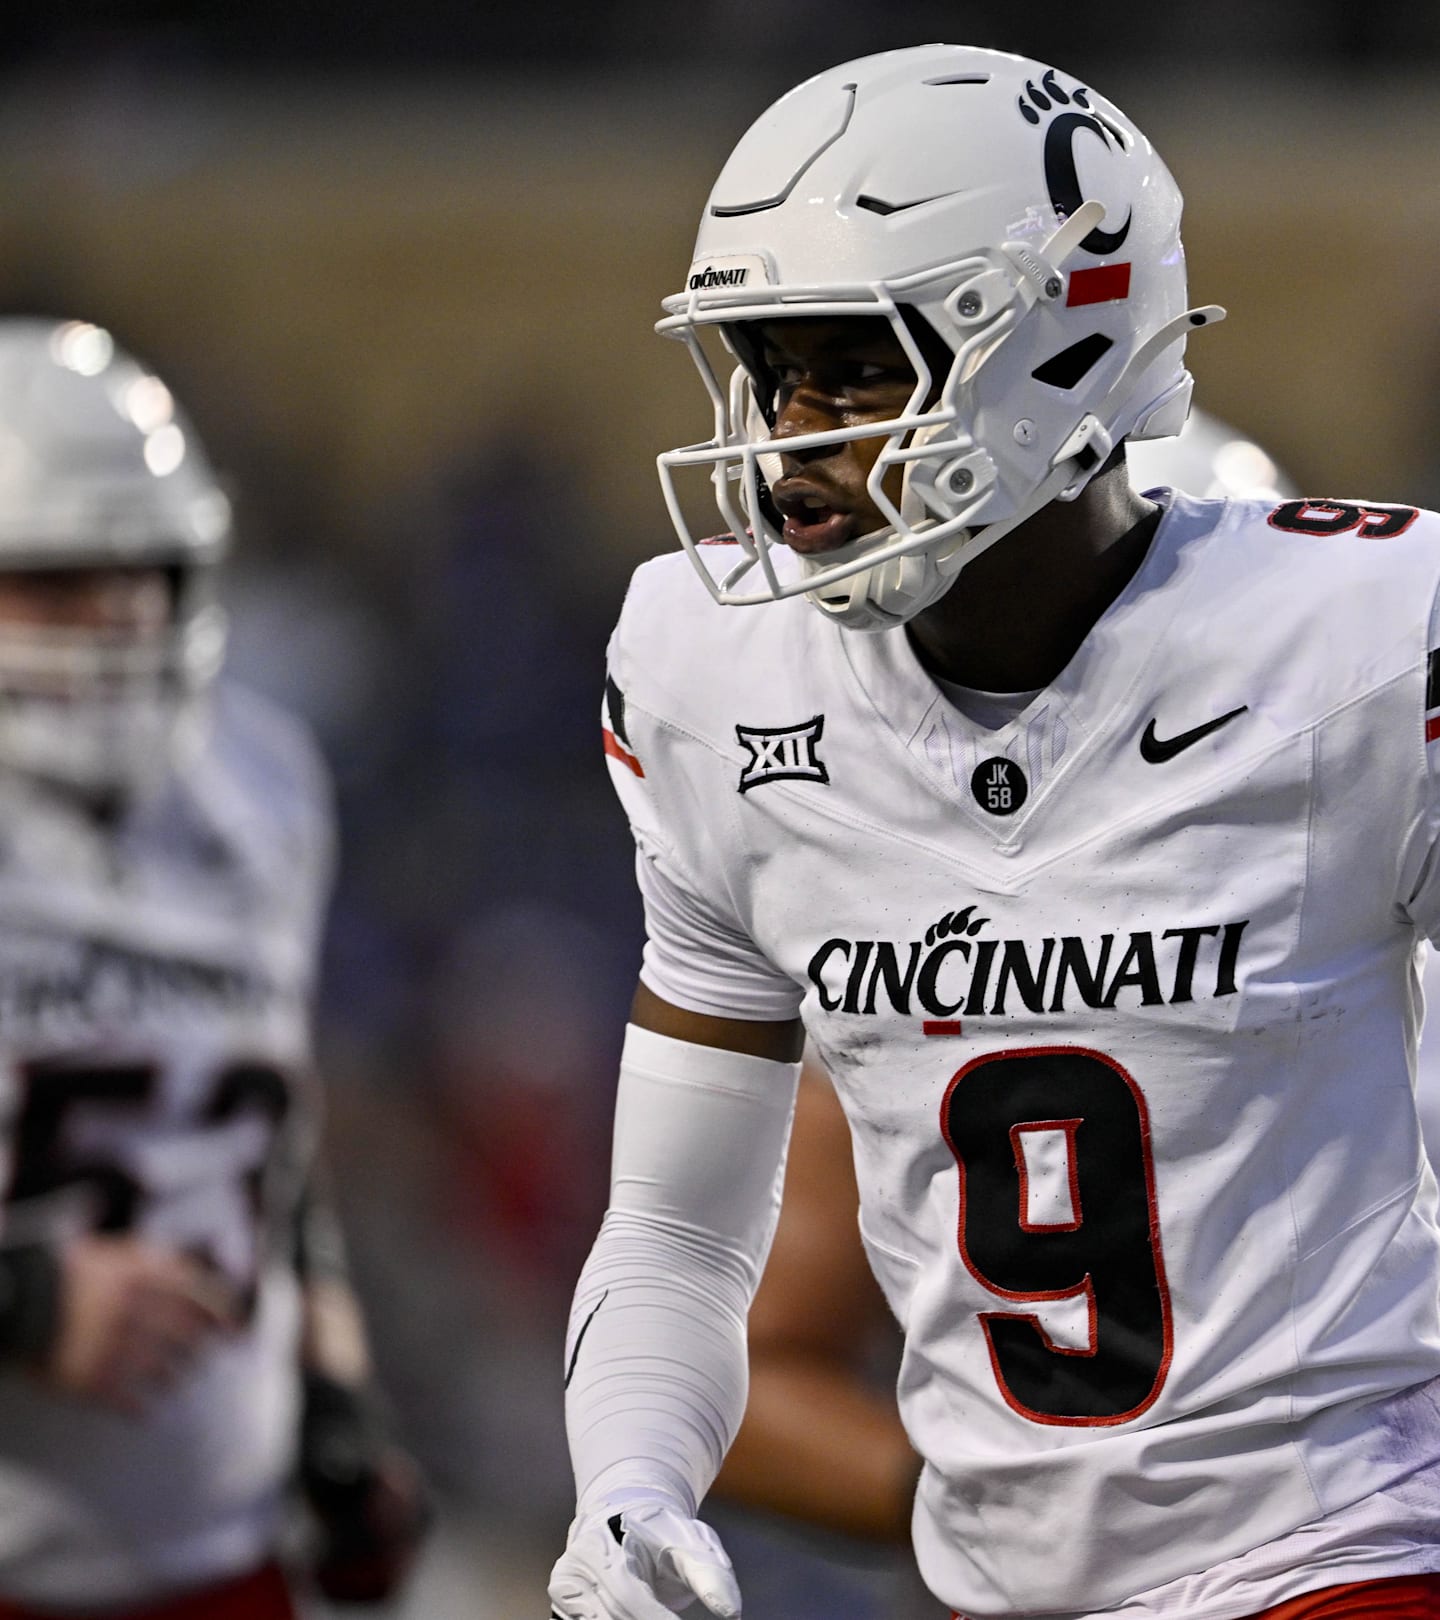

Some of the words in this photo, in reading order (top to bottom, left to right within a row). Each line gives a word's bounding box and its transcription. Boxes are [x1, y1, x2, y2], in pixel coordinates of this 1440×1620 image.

[689, 267, 747, 290] CINCINNATI
[747, 735, 812, 774] XII
[986, 764, 1009, 785] JK
[987, 787, 1012, 808] 58
[807, 918, 1249, 1017] CINCINNATI
[940, 1046, 1174, 1428] 9
